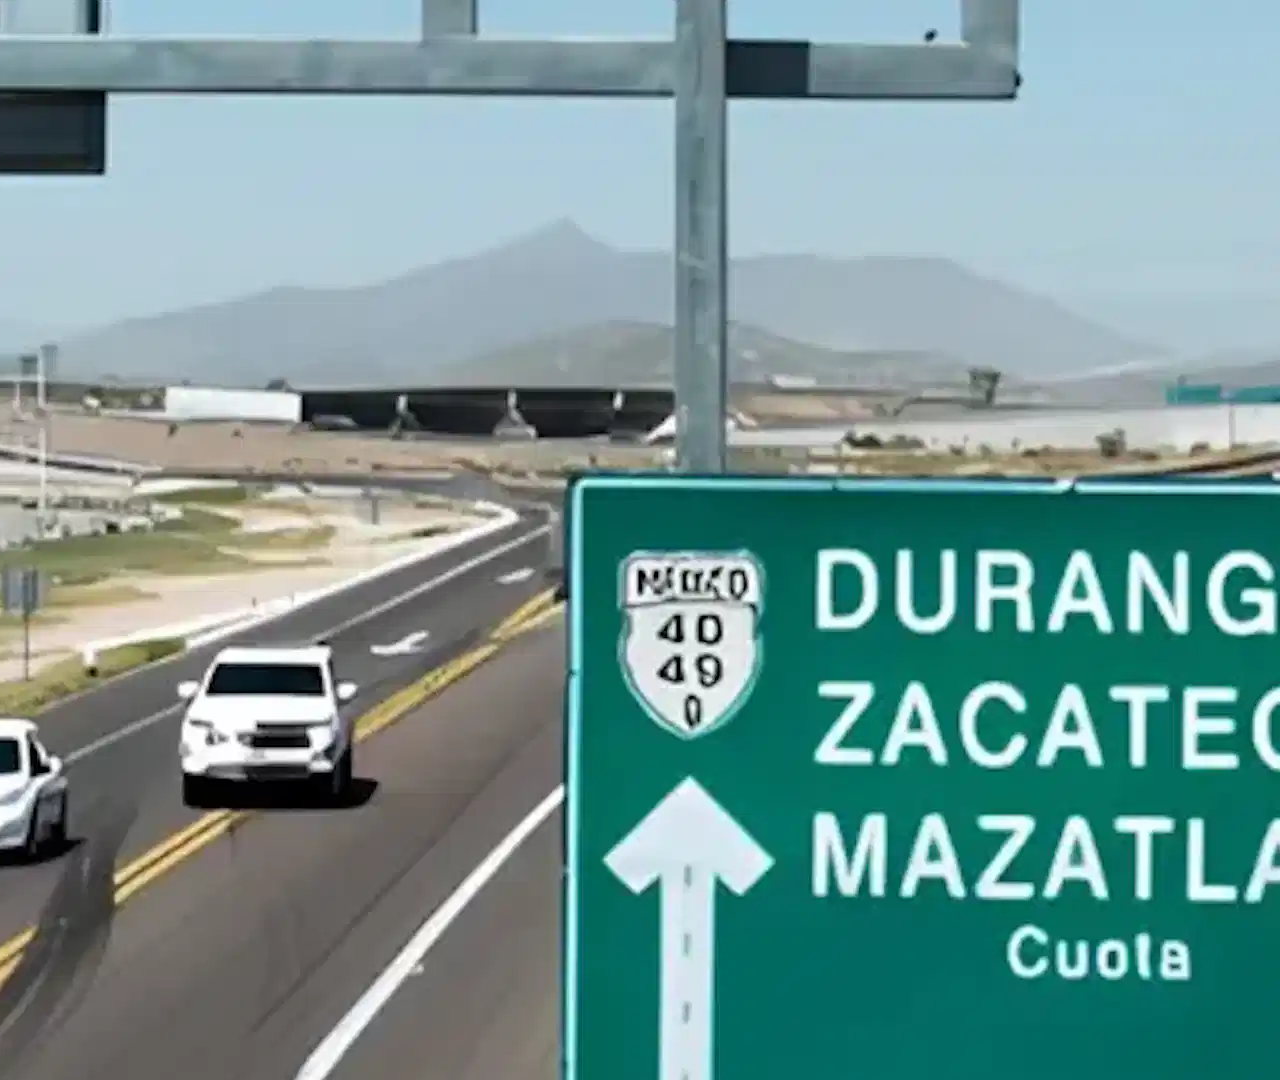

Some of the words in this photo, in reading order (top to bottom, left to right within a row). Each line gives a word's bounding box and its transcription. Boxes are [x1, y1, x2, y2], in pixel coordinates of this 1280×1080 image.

[656, 614, 724, 645] 40
[655, 652, 724, 688] 49
[1006, 925, 1191, 980] Cuota
